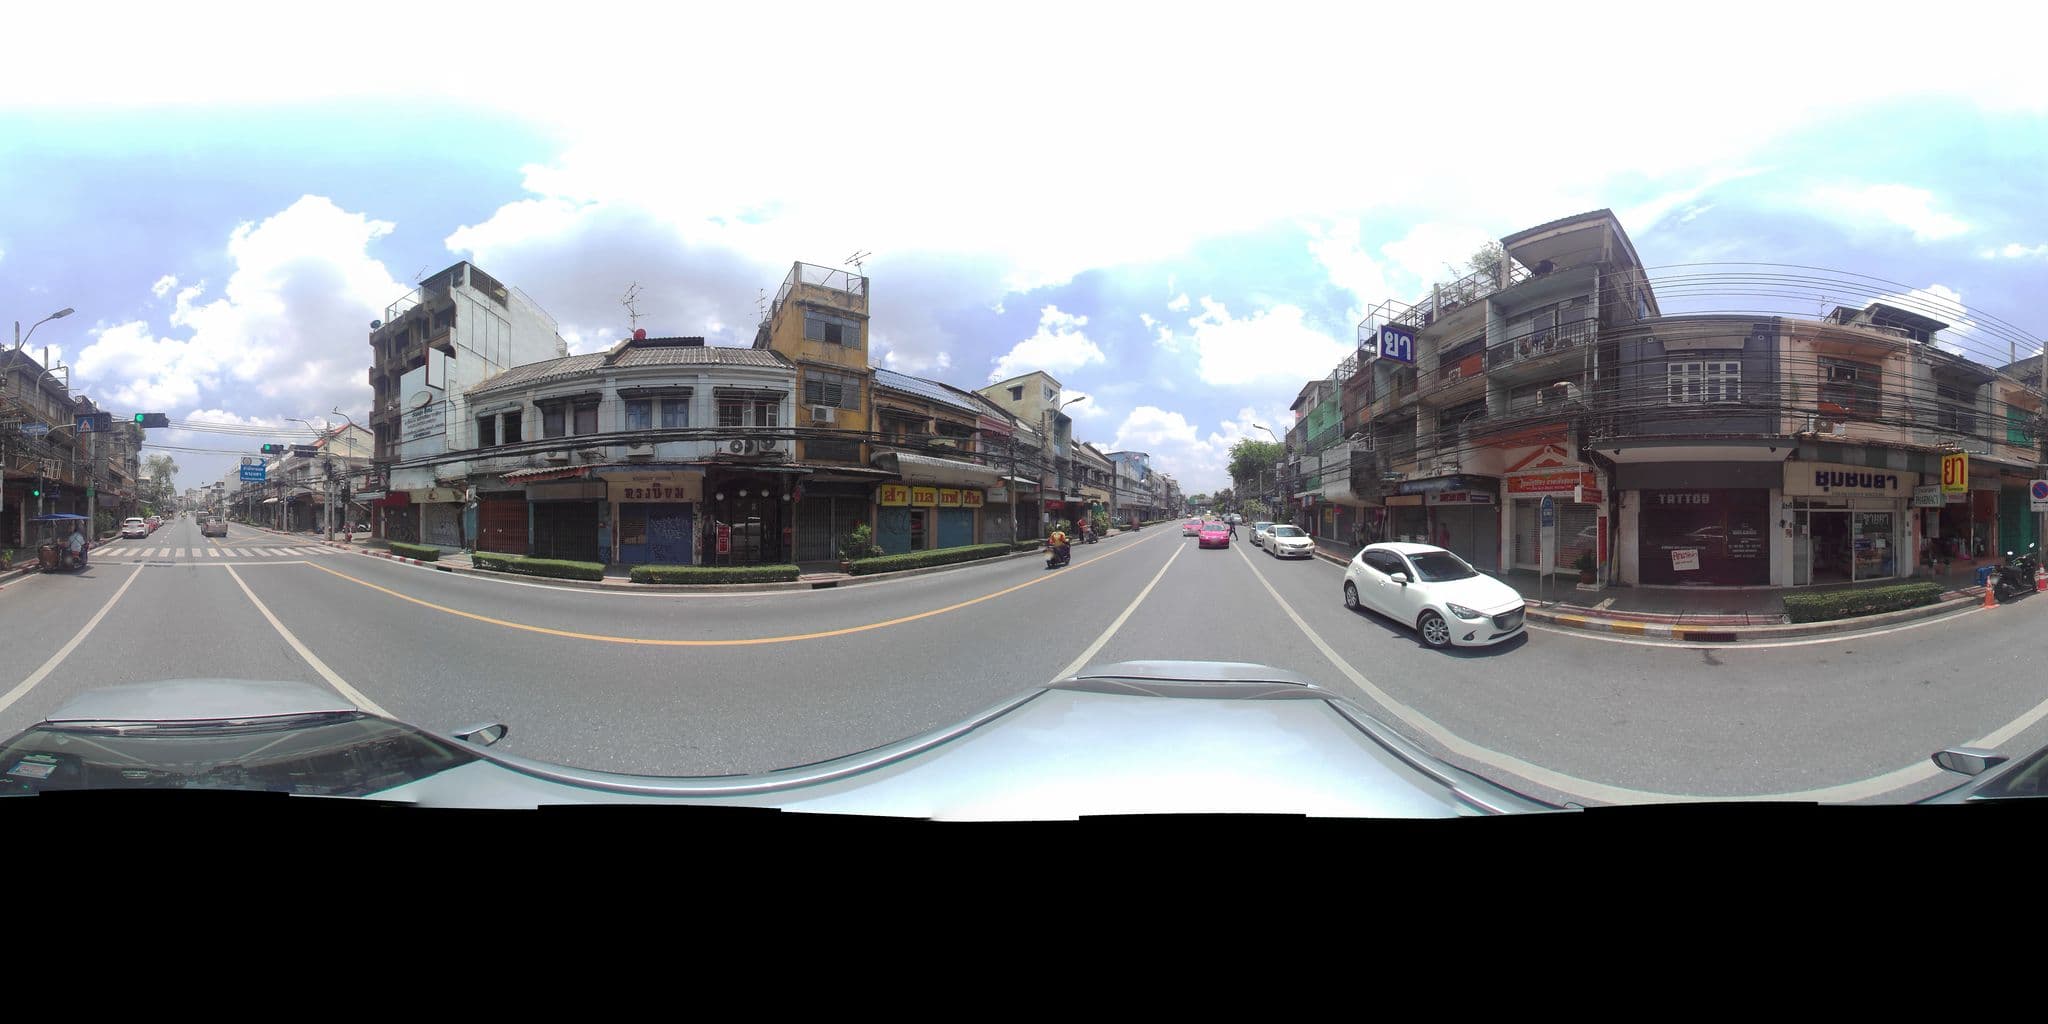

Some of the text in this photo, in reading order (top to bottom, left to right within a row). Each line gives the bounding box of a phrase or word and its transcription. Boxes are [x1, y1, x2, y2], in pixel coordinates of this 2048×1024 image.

[1384, 331, 1411, 361] ยา
[1944, 457, 1965, 485] ยา
[1659, 493, 1710, 504] TATTOO
